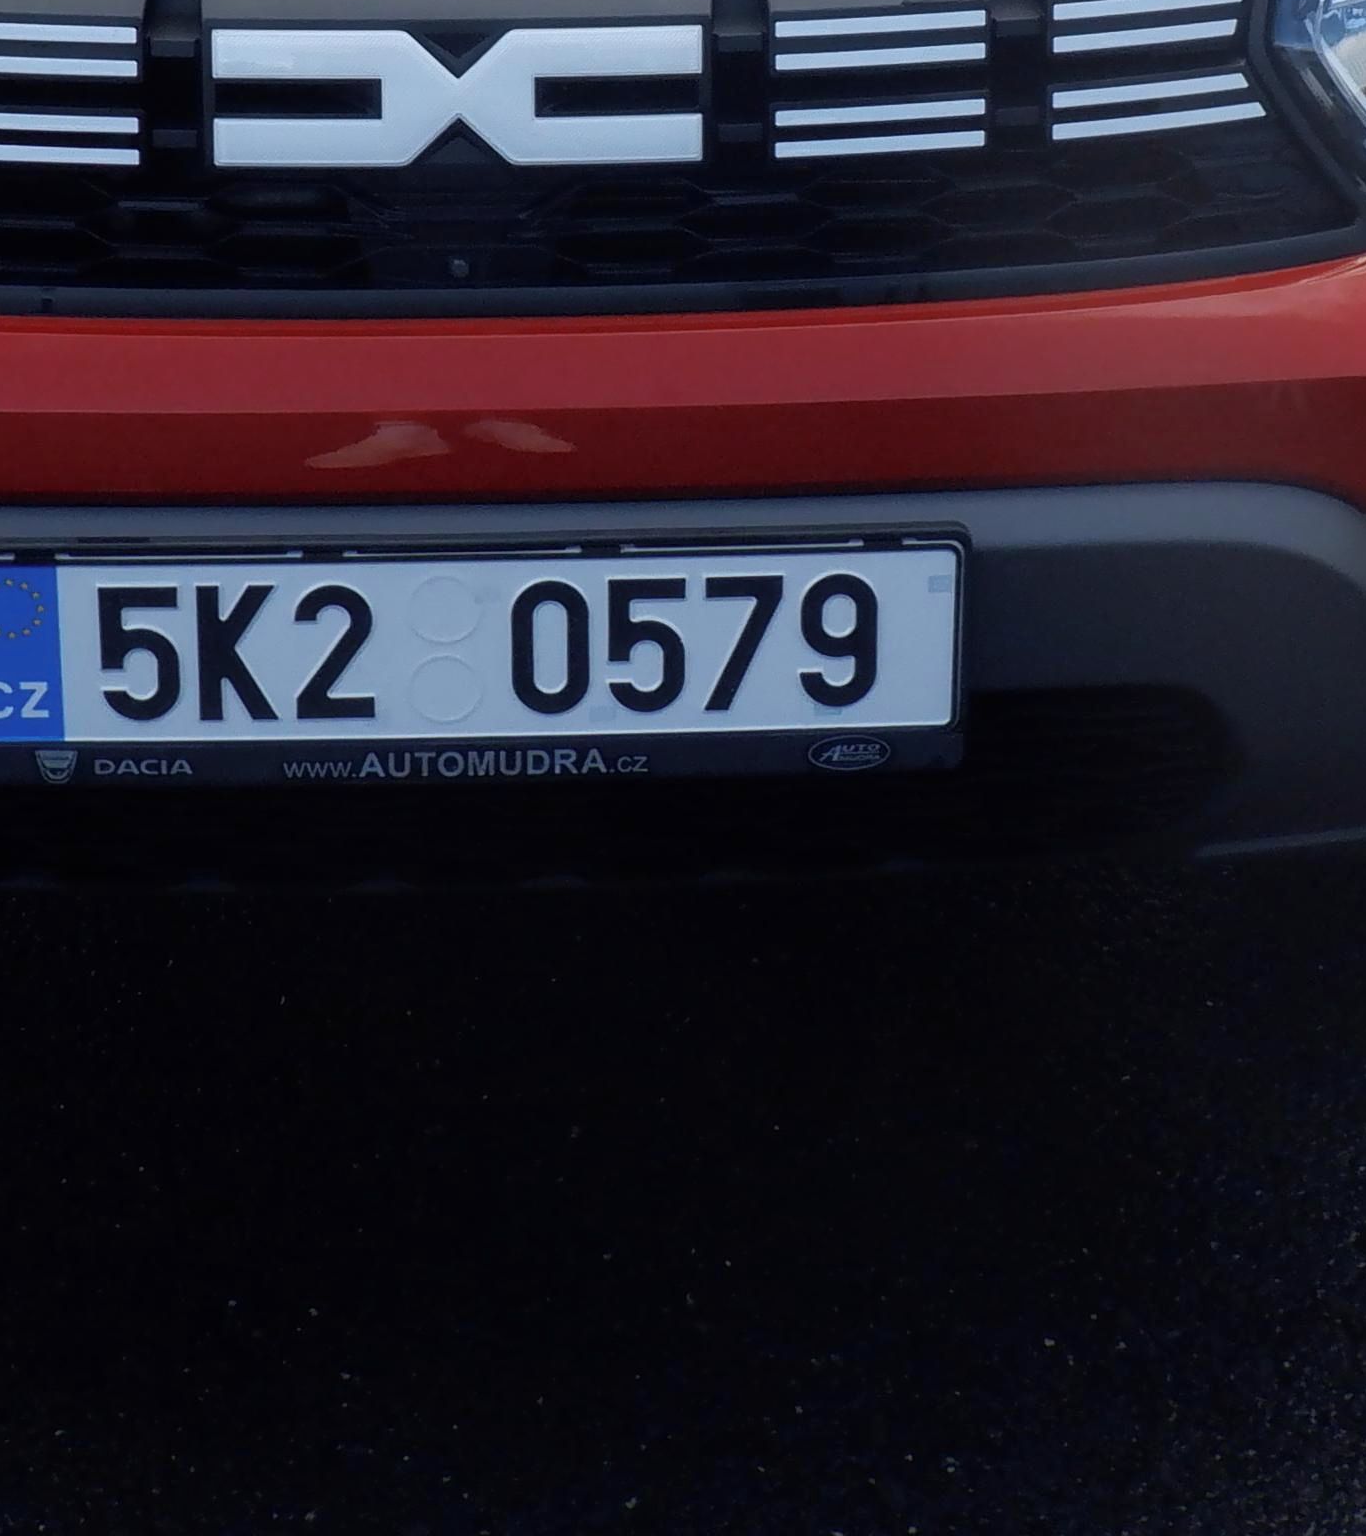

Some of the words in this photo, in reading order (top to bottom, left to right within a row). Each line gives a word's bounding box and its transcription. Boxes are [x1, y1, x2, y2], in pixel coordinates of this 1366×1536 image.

[97, 584, 376, 721] 5K2
[511, 573, 878, 714] 0579
[94, 759, 193, 775] DACIA
[283, 748, 648, 778] www.AUTOMUDRA.cz
